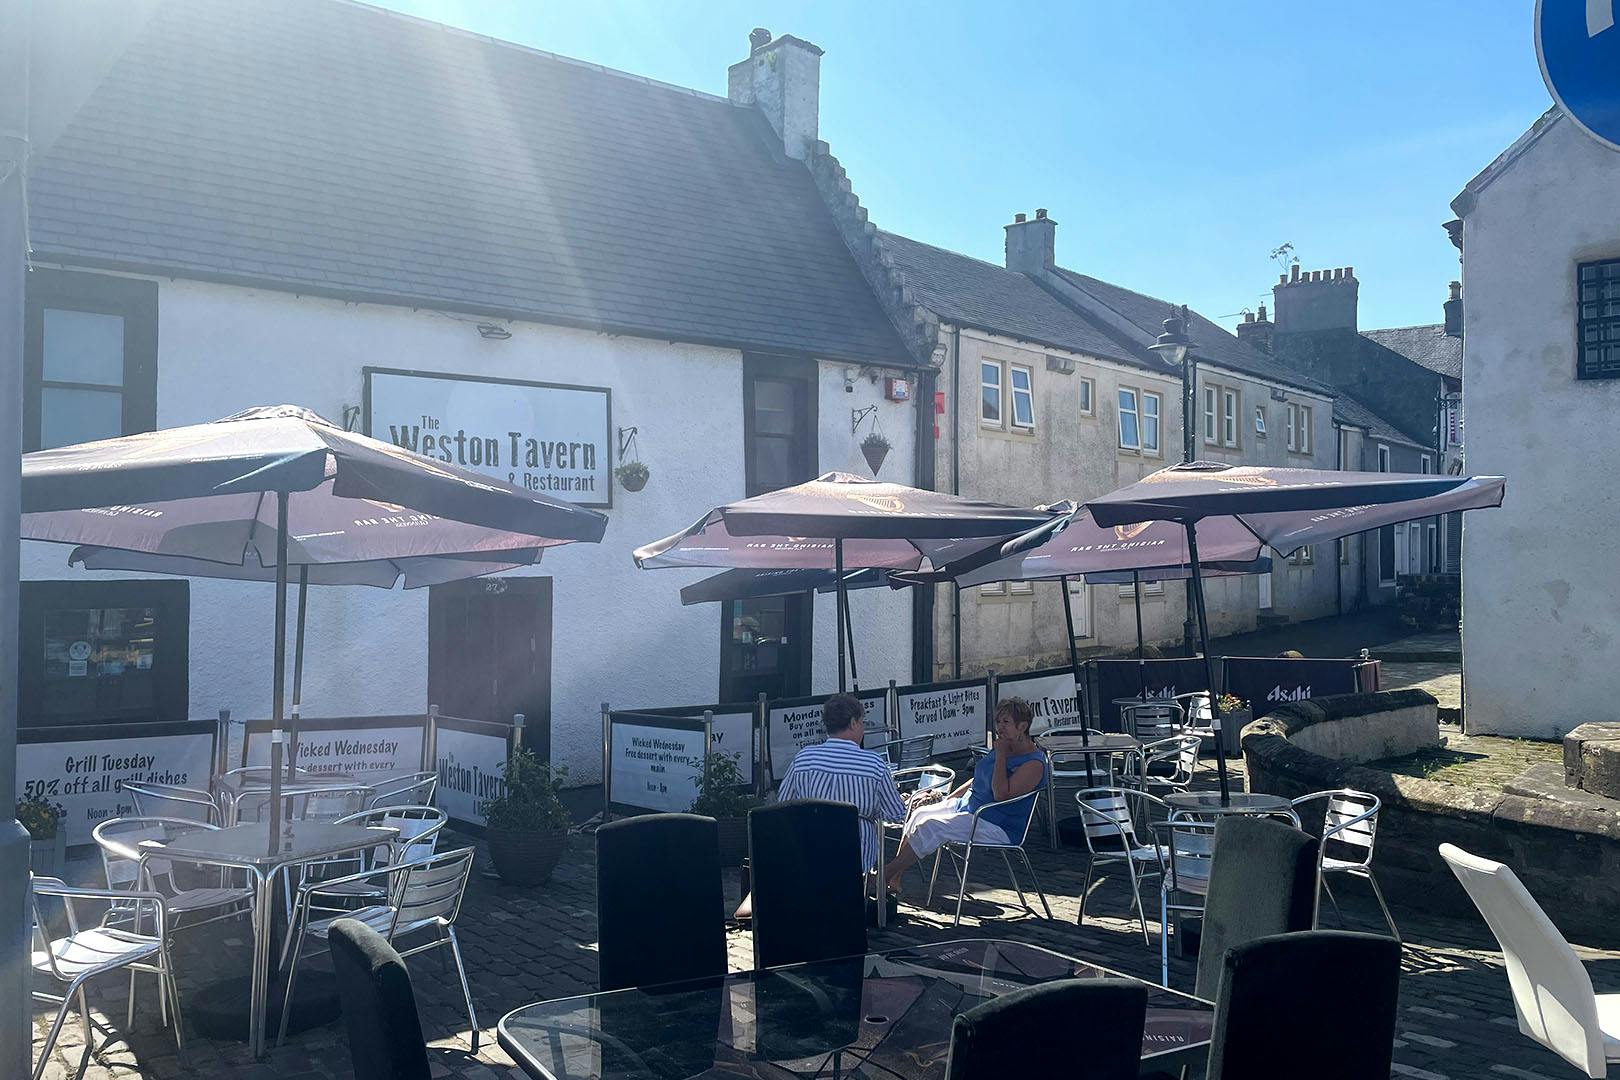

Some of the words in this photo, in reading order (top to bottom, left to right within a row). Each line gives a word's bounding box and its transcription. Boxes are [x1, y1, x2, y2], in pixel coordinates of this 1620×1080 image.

[422, 415, 440, 430] The
[389, 425, 500, 467] Weston
[508, 432, 596, 470] Tavern
[524, 472, 595, 492] Restaurant
[910, 697, 941, 710] Breakfast
[948, 692, 964, 706] Light
[964, 690, 980, 702] Bites
[1267, 684, 1311, 702] Asahi
[783, 709, 824, 724] Monda
[914, 709, 938, 724] Served
[940, 706, 957, 720] 10am
[962, 703, 974, 717] 3pm
[789, 722, 804, 732] Buy
[806, 720, 819, 728] one
[804, 728, 814, 738] all
[335, 739, 398, 757] Wednesday
[632, 737, 652, 748] Wicked
[653, 738, 686, 752] Wednesday
[65, 755, 98, 773] Grill
[101, 754, 156, 773] Tuesday
[307, 762, 342, 772] dessert
[344, 760, 367, 770] with
[370, 761, 396, 770] every
[626, 748, 636, 758] Free
[636, 750, 658, 761] dessert
[658, 753, 672, 762] with
[674, 755, 690, 766] every
[650, 764, 666, 773] main
[24, 778, 60, 799] 50%
[64, 776, 88, 795] off
[92, 775, 110, 792] all
[146, 770, 188, 786] dishes
[439, 758, 472, 794] Weston
[473, 765, 506, 801] Tavern
[87, 808, 108, 820] Noon
[116, 804, 132, 818] 8pm
